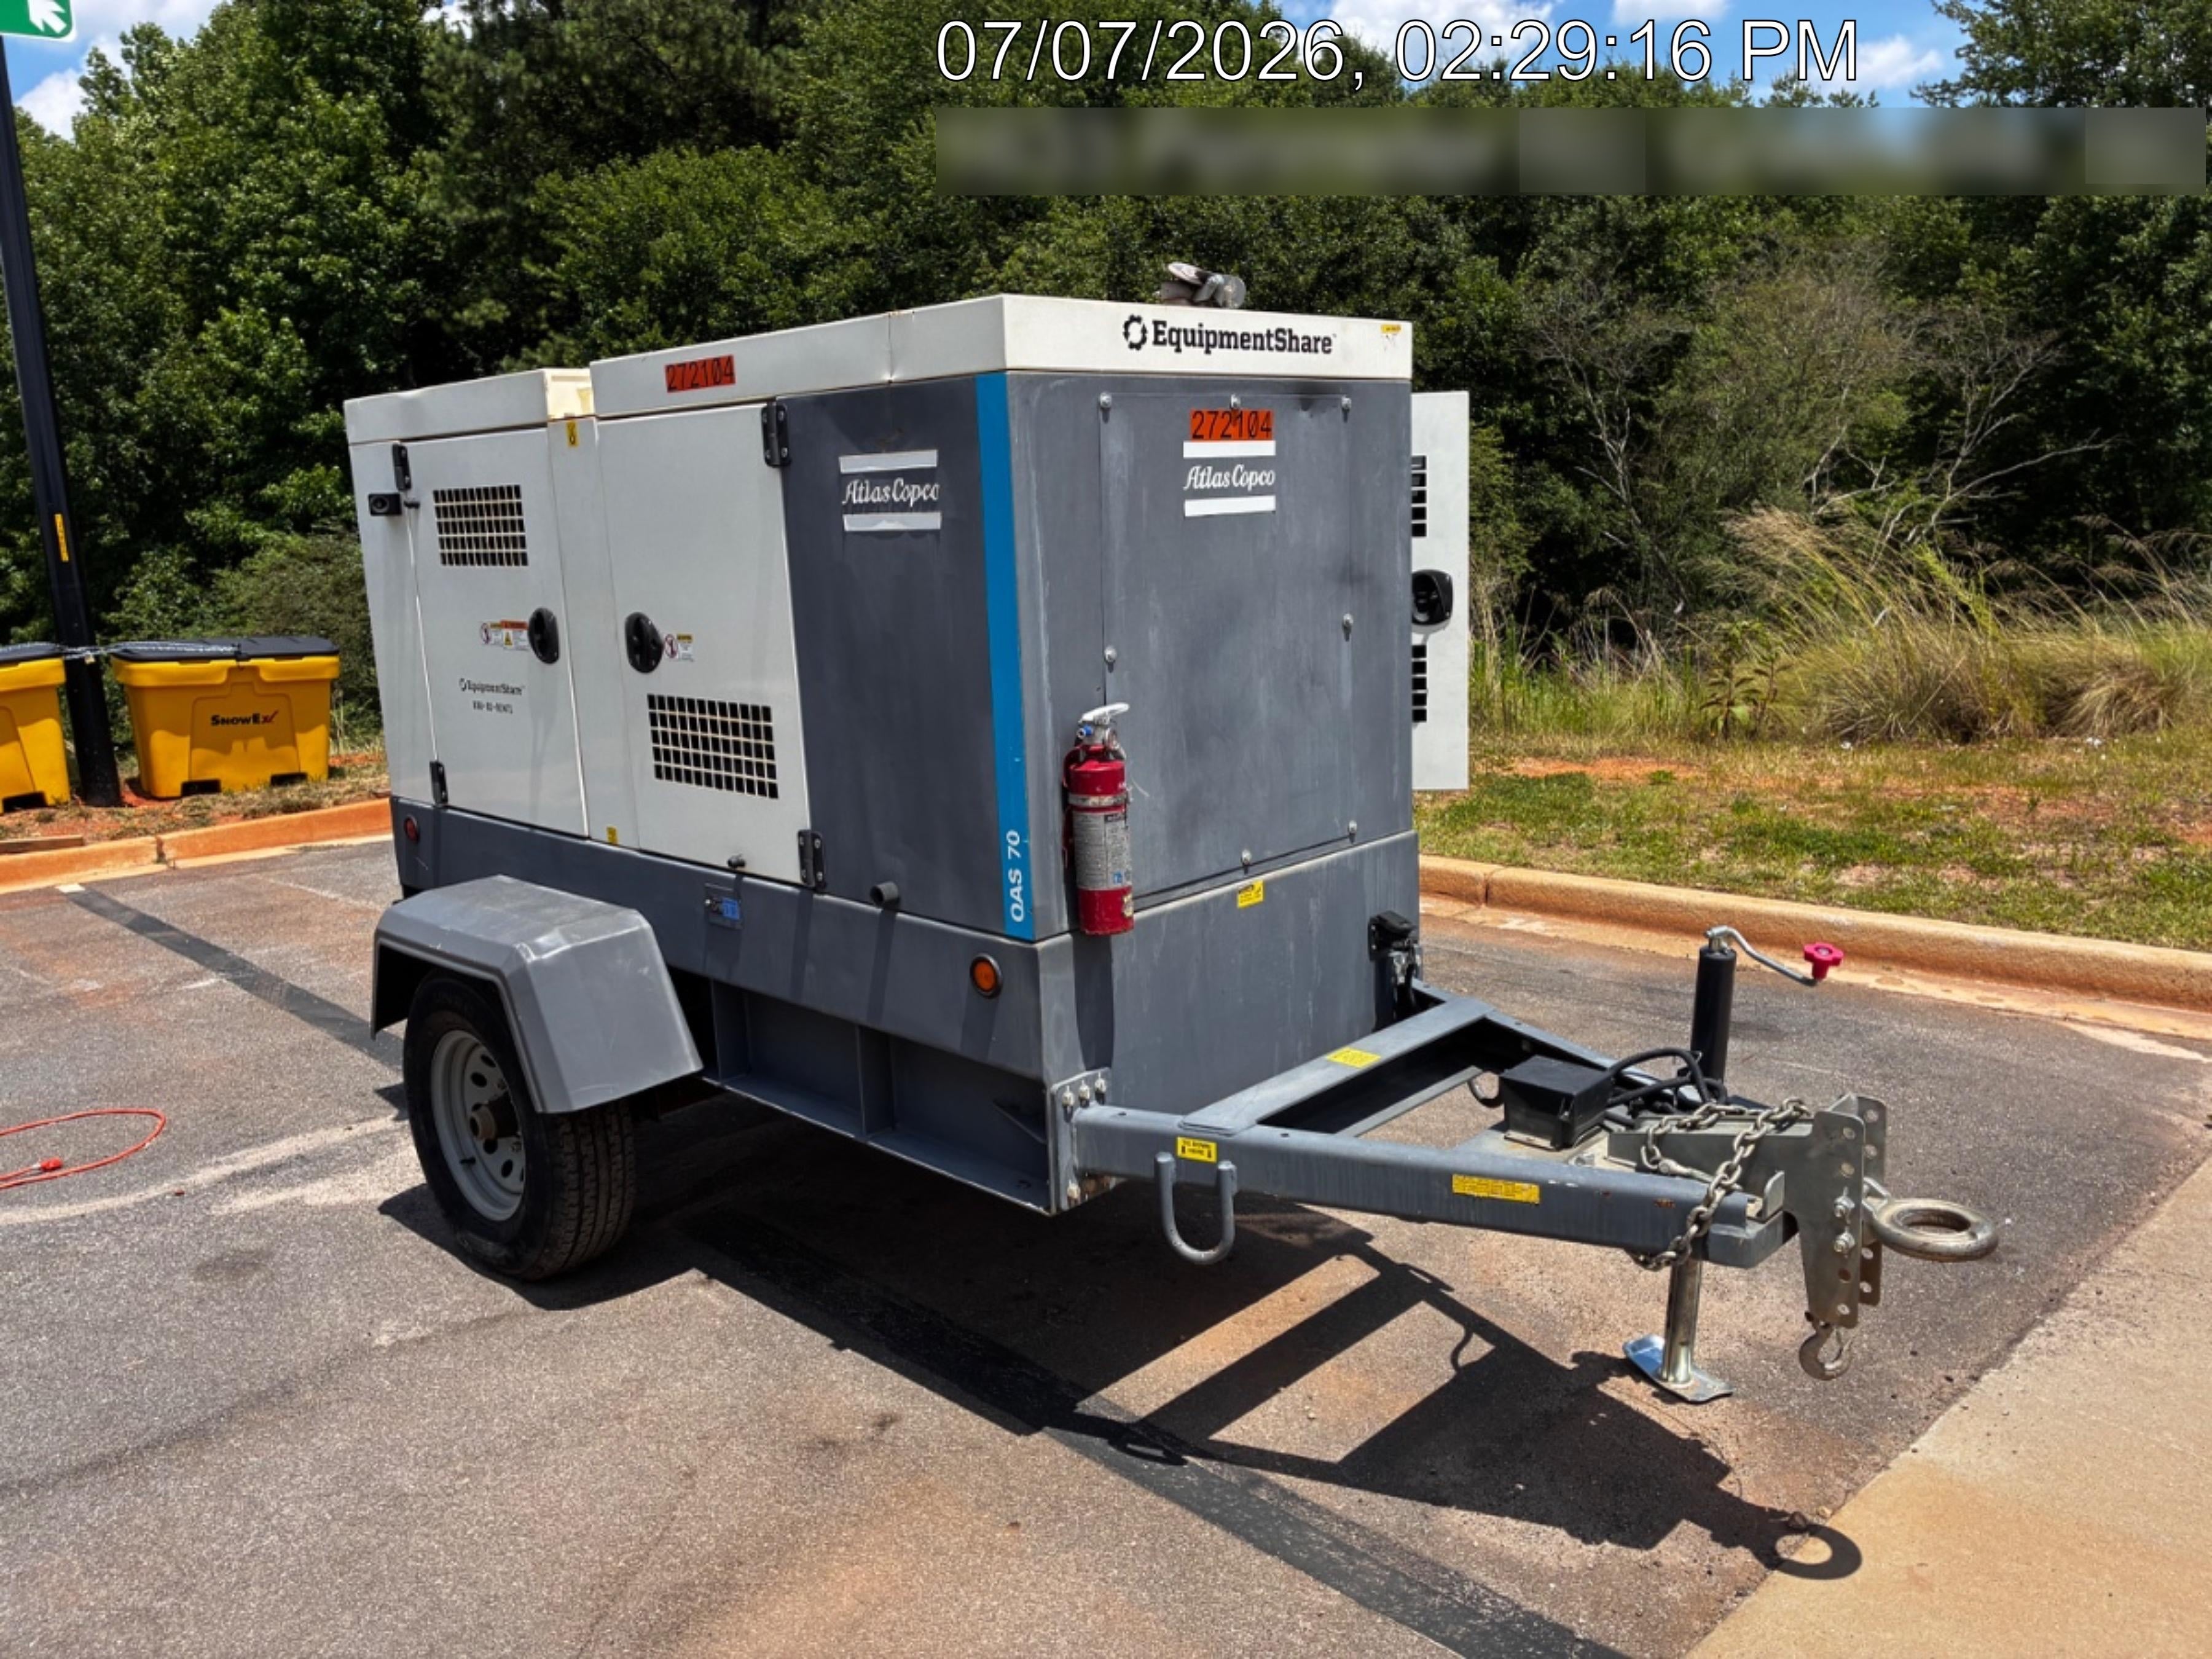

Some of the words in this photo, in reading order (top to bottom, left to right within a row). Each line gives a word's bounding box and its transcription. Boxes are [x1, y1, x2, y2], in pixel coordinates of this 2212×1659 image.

[1152, 320, 1333, 355] EquipmentShare
[665, 355, 735, 392] 272104
[1192, 410, 1273, 439] 272104
[842, 479, 891, 505] Atlas
[892, 477, 940, 508] Copco
[1183, 465, 1230, 490] Atlas
[1232, 463, 1276, 492] Copco
[1005, 830, 1022, 860] 70
[1008, 868, 1025, 922] QAS
